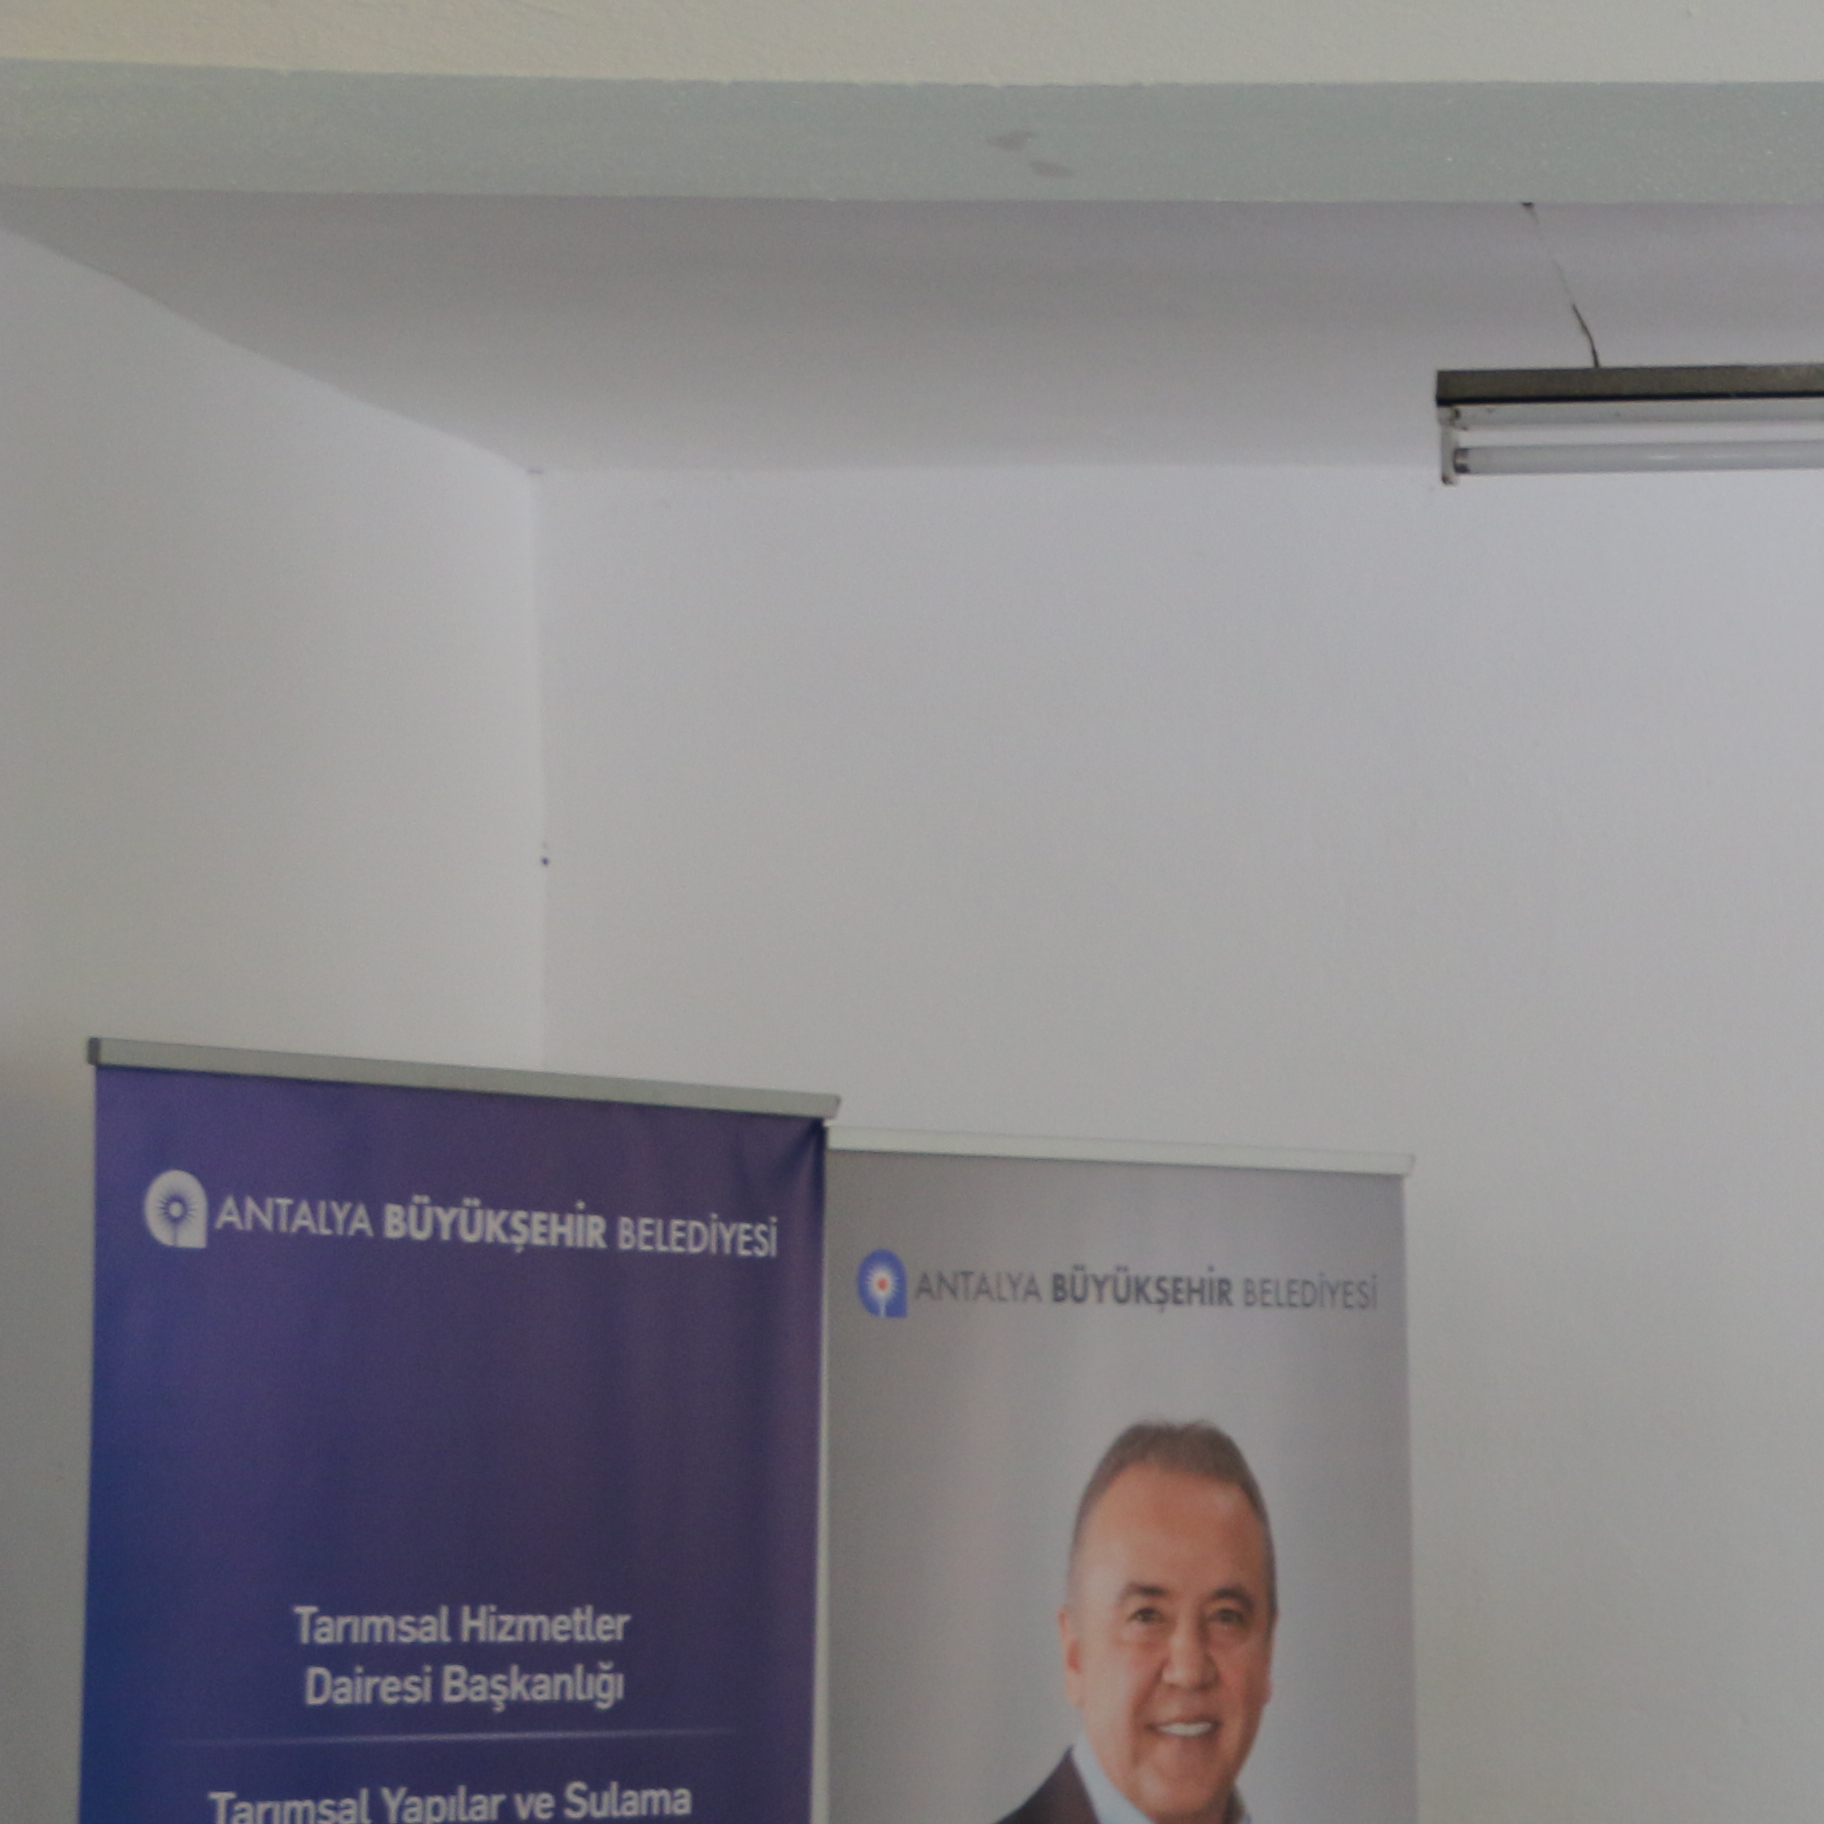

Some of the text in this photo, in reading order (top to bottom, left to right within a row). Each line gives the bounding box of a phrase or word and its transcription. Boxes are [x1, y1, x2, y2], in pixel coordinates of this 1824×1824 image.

[214, 1194, 778, 1258] ANTALYA BÜYÜKŞEHİR BELEDİYESİ
[913, 1265, 1379, 1312] ANTALYA BÜYÜKŞEHİR BELEDİYESİ
[292, 1604, 632, 1645] Tarımsal Hizmetler
[305, 1661, 625, 1713] Dairesi Başkanlığı
[513, 1791, 556, 1821] ve
[563, 1780, 692, 1820] Sulama
